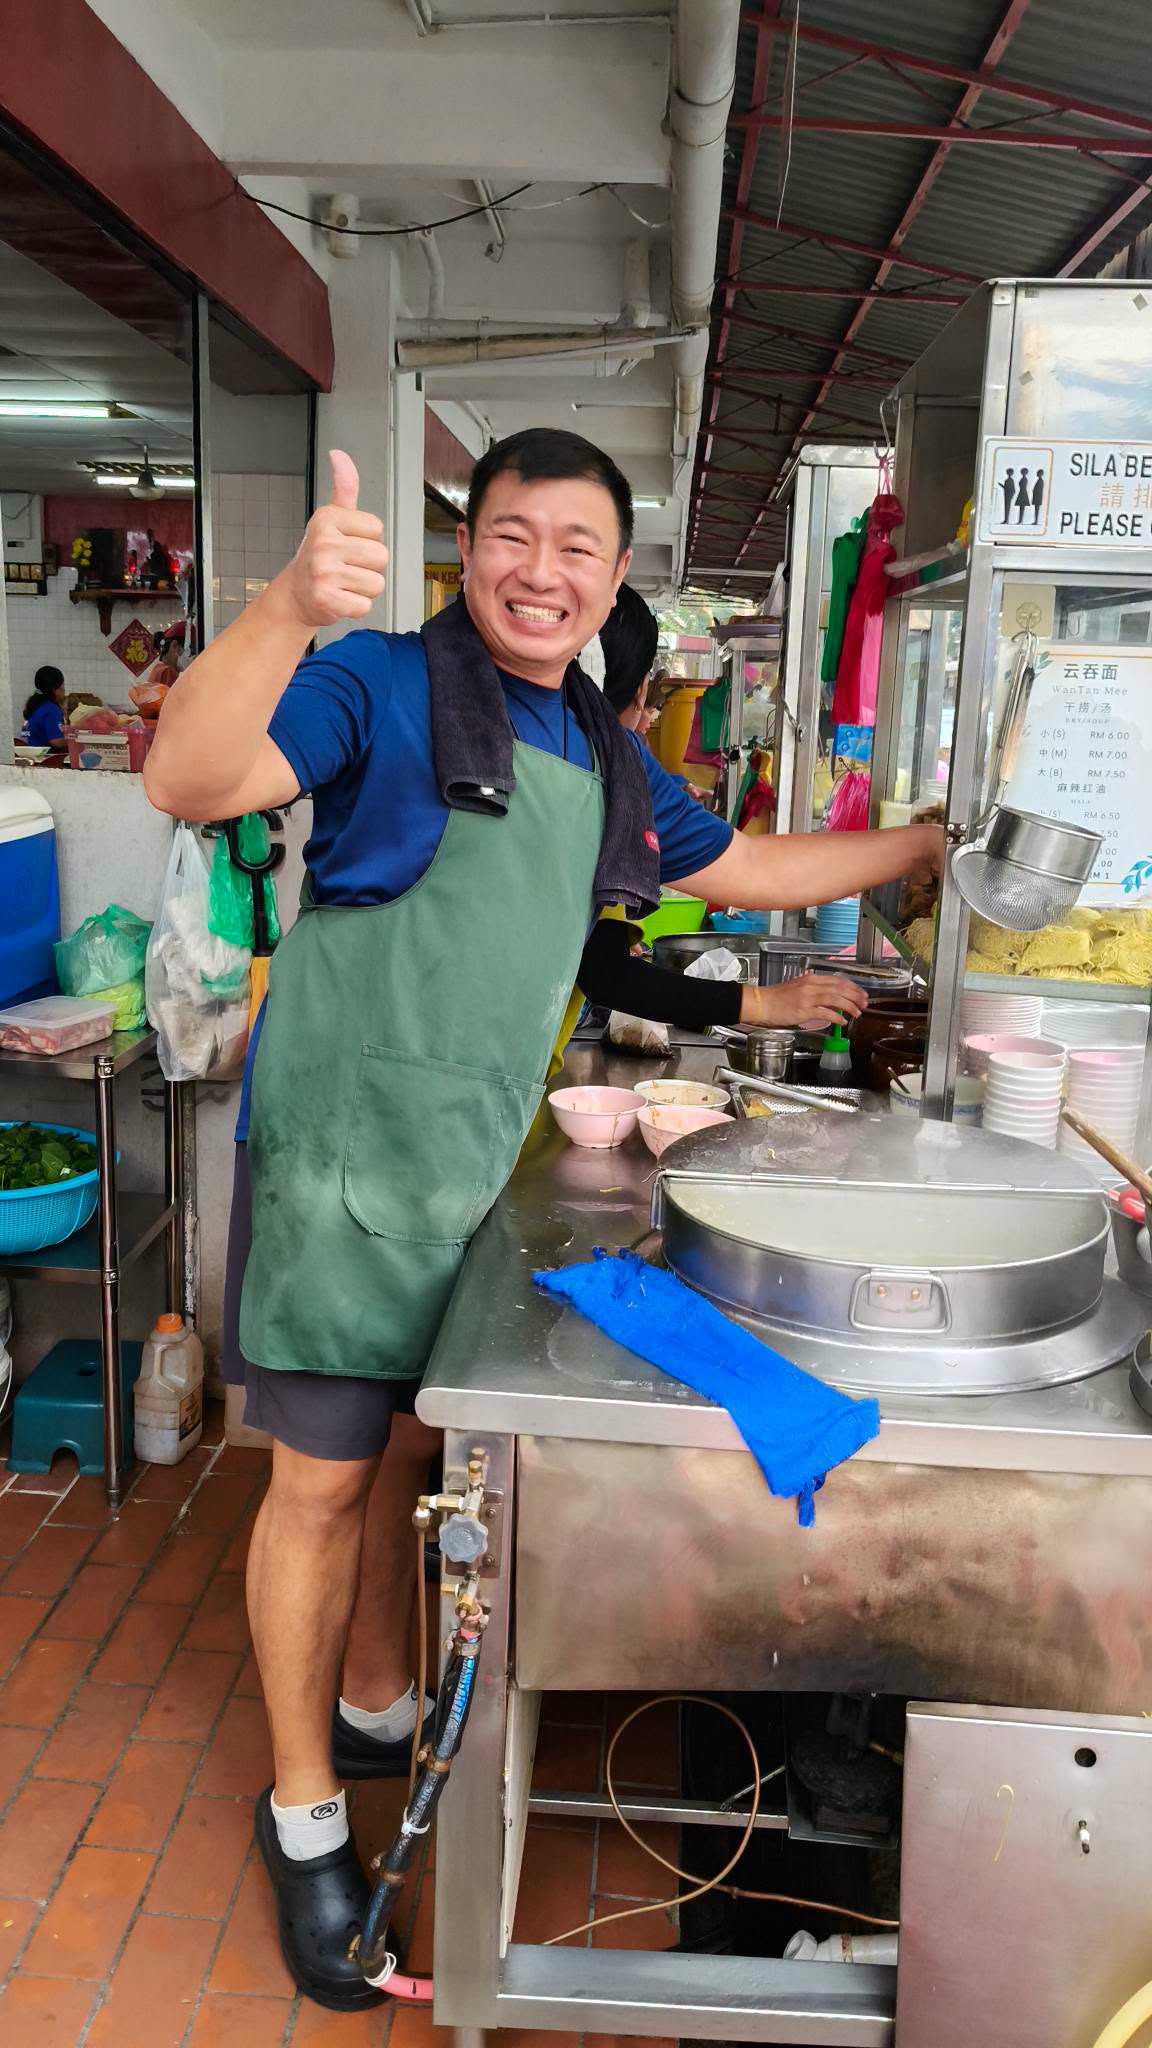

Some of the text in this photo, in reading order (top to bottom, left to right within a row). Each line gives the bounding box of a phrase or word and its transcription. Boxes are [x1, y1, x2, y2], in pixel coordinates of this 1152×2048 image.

[1070, 453, 1117, 477] SILA
[1060, 512, 1144, 537] PLEASE
[126, 639, 149, 663] 福
[1063, 663, 1119, 681] 云吞面
[1104, 686, 1129, 696] Mee
[1052, 728, 1067, 741] (S)
[1090, 730, 1105, 740] RM
[1107, 731, 1131, 741] 6.00
[1039, 748, 1128, 761] 中 (M) RM 7.00
[1038, 767, 1126, 779] 大 (B) RM 7.50
[1057, 783, 1106, 794] 麻辣红油
[1084, 811, 1098, 820] RM
[1100, 811, 1121, 821] 6.50
